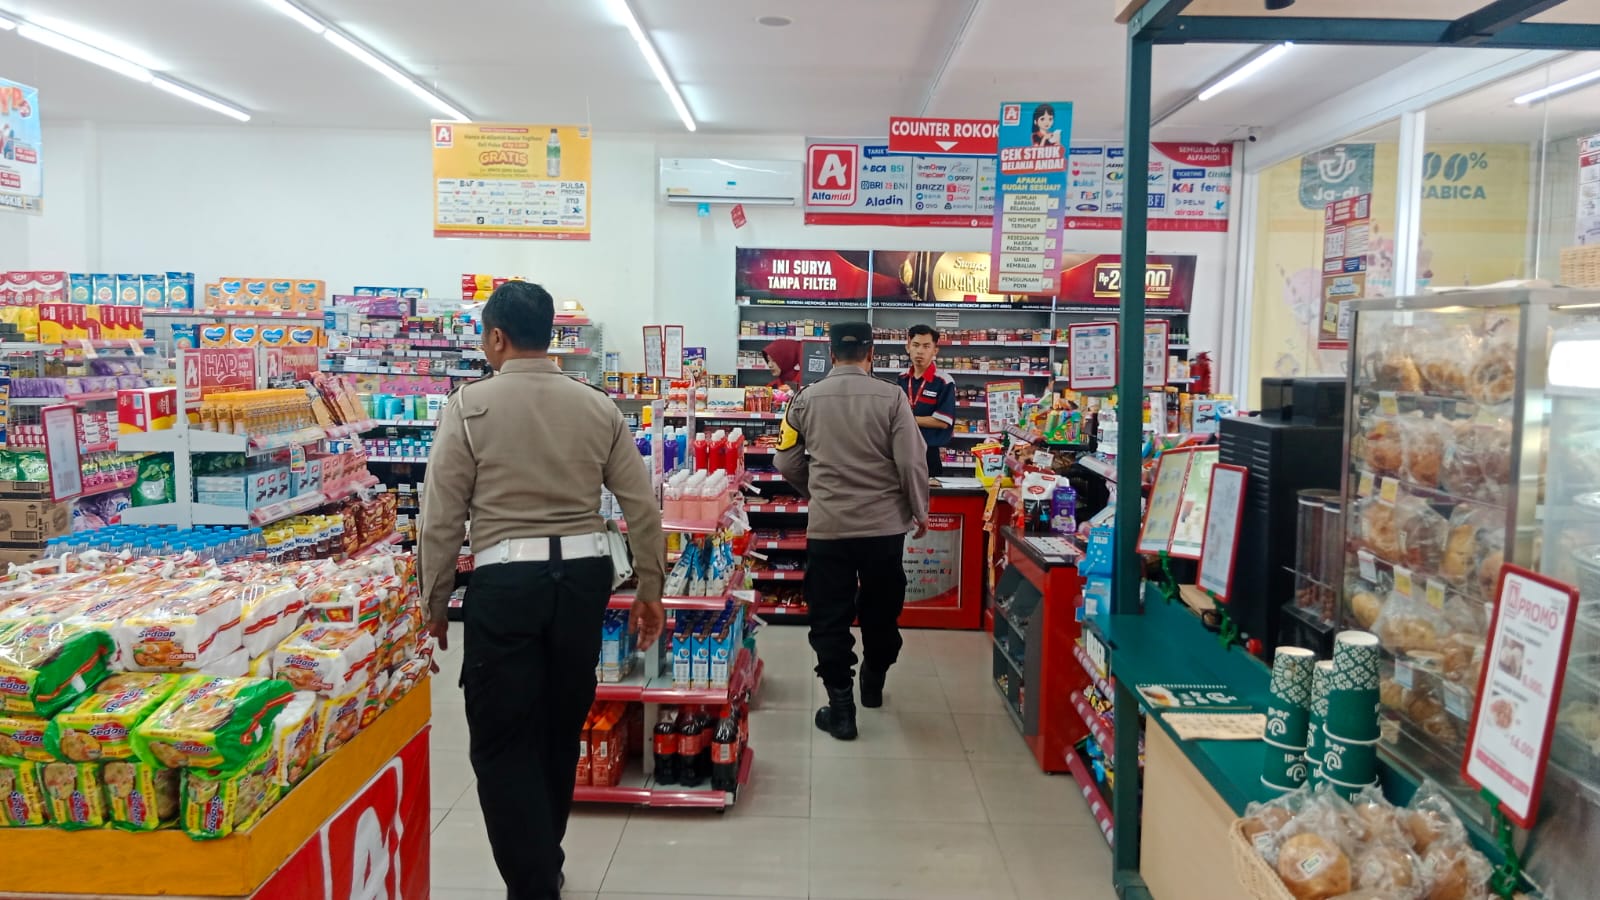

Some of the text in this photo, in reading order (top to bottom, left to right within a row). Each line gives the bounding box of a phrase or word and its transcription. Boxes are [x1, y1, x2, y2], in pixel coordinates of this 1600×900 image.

[892, 121, 1000, 139] COUNTER ROKOK
[479, 150, 529, 166] GRATIS
[1001, 148, 1024, 161] CEK
[1024, 146, 1061, 160] STRUK
[870, 165, 887, 173] BCA
[890, 164, 904, 173] BSI
[1002, 158, 1064, 171] BELANJA ANDA!
[818, 153, 847, 188] A
[954, 174, 974, 182] gopay
[1016, 176, 1047, 184] APAKAH
[869, 181, 883, 190] BRI
[893, 181, 908, 190] BNI
[915, 183, 945, 192] BRIZZI
[1002, 183, 1028, 191] SUDAH
[811, 191, 851, 202] Alfamidi
[865, 194, 904, 207] Aladin
[772, 259, 832, 276] INI SURYA
[767, 276, 837, 291] TANPA FILTER
[1517, 597, 1559, 632] PROMO
[138, 630, 176, 639] Sedaap
[285, 656, 320, 668] Sedaap
[0, 680, 30, 691] edaap
[173, 743, 214, 753] Sedaap
